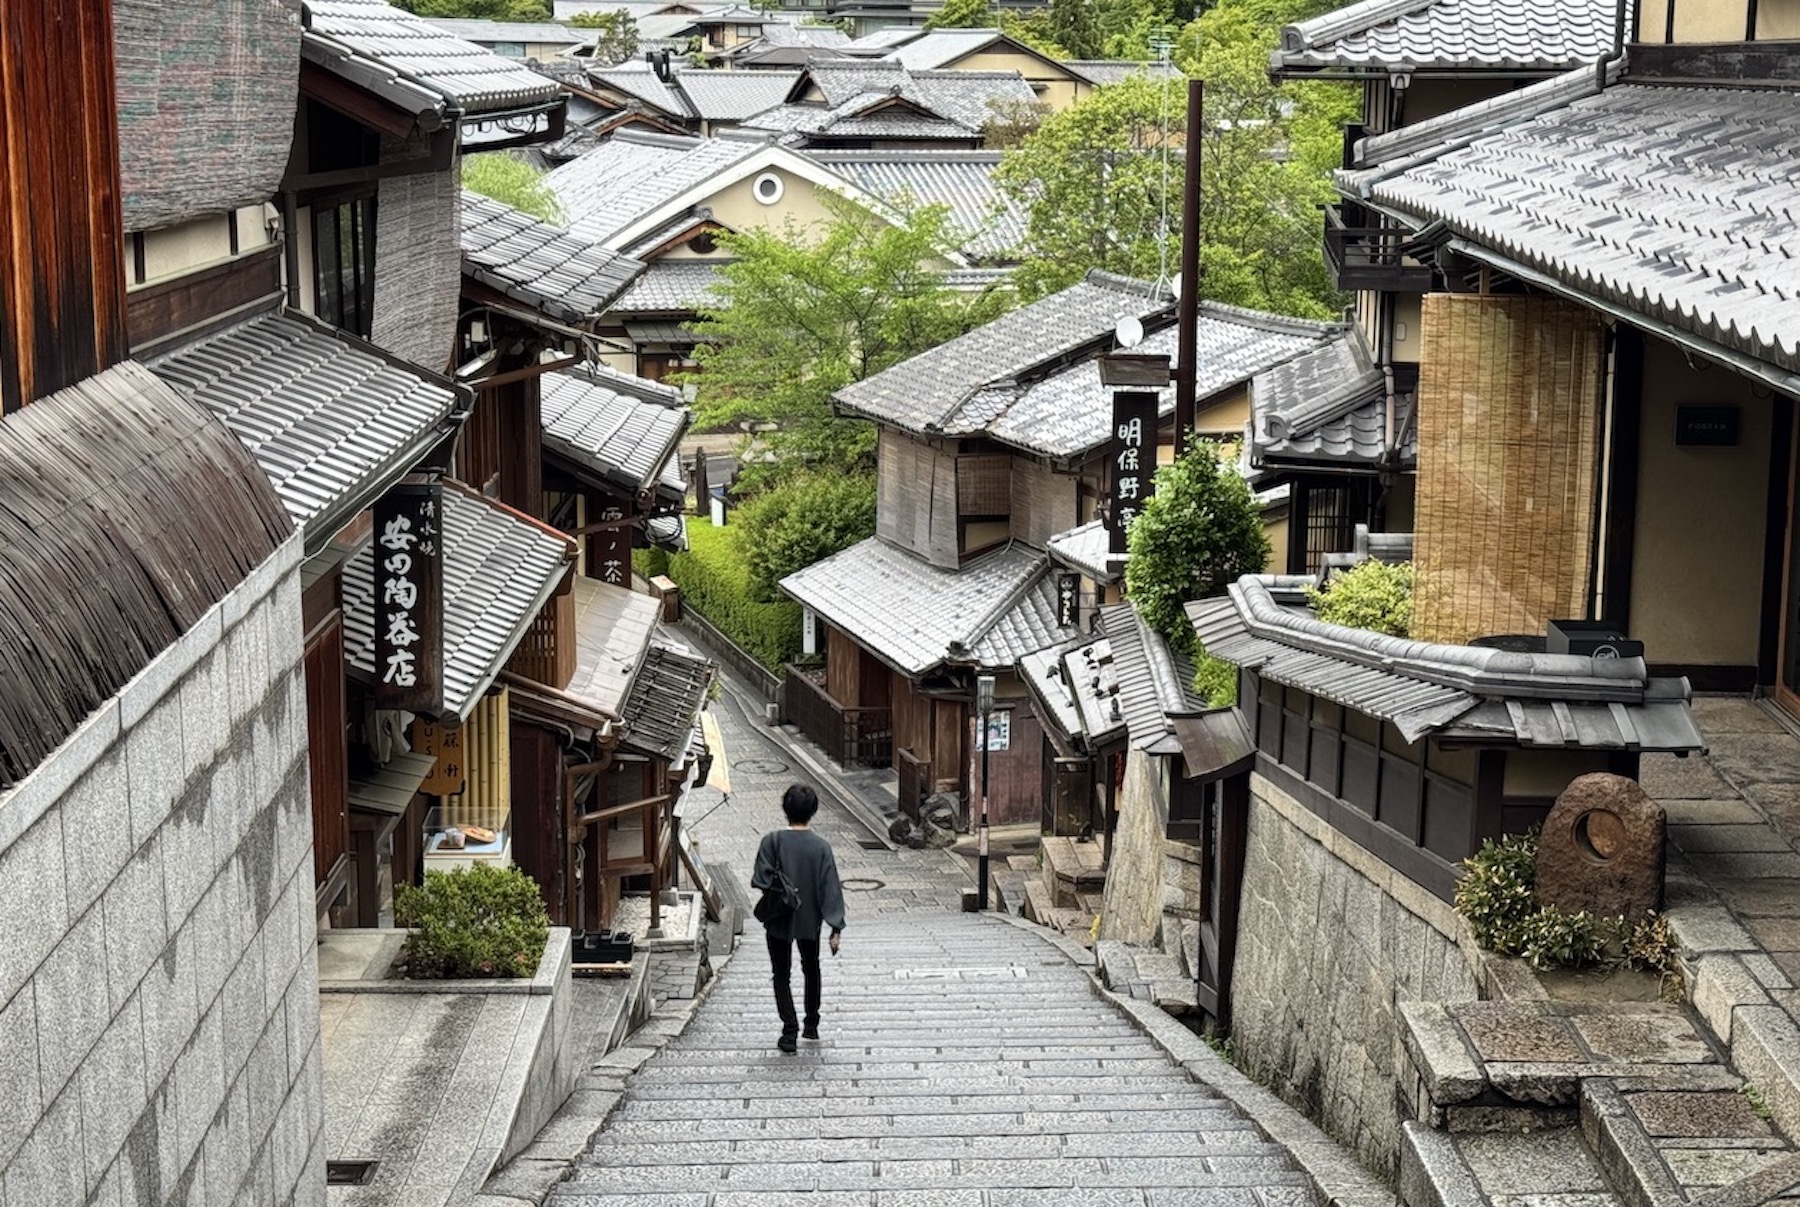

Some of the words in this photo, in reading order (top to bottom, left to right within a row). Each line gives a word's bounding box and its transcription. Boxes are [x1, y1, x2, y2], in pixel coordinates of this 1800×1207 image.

[419, 500, 437, 557] 清水焼
[601, 506, 623, 583] 雲ノ茶
